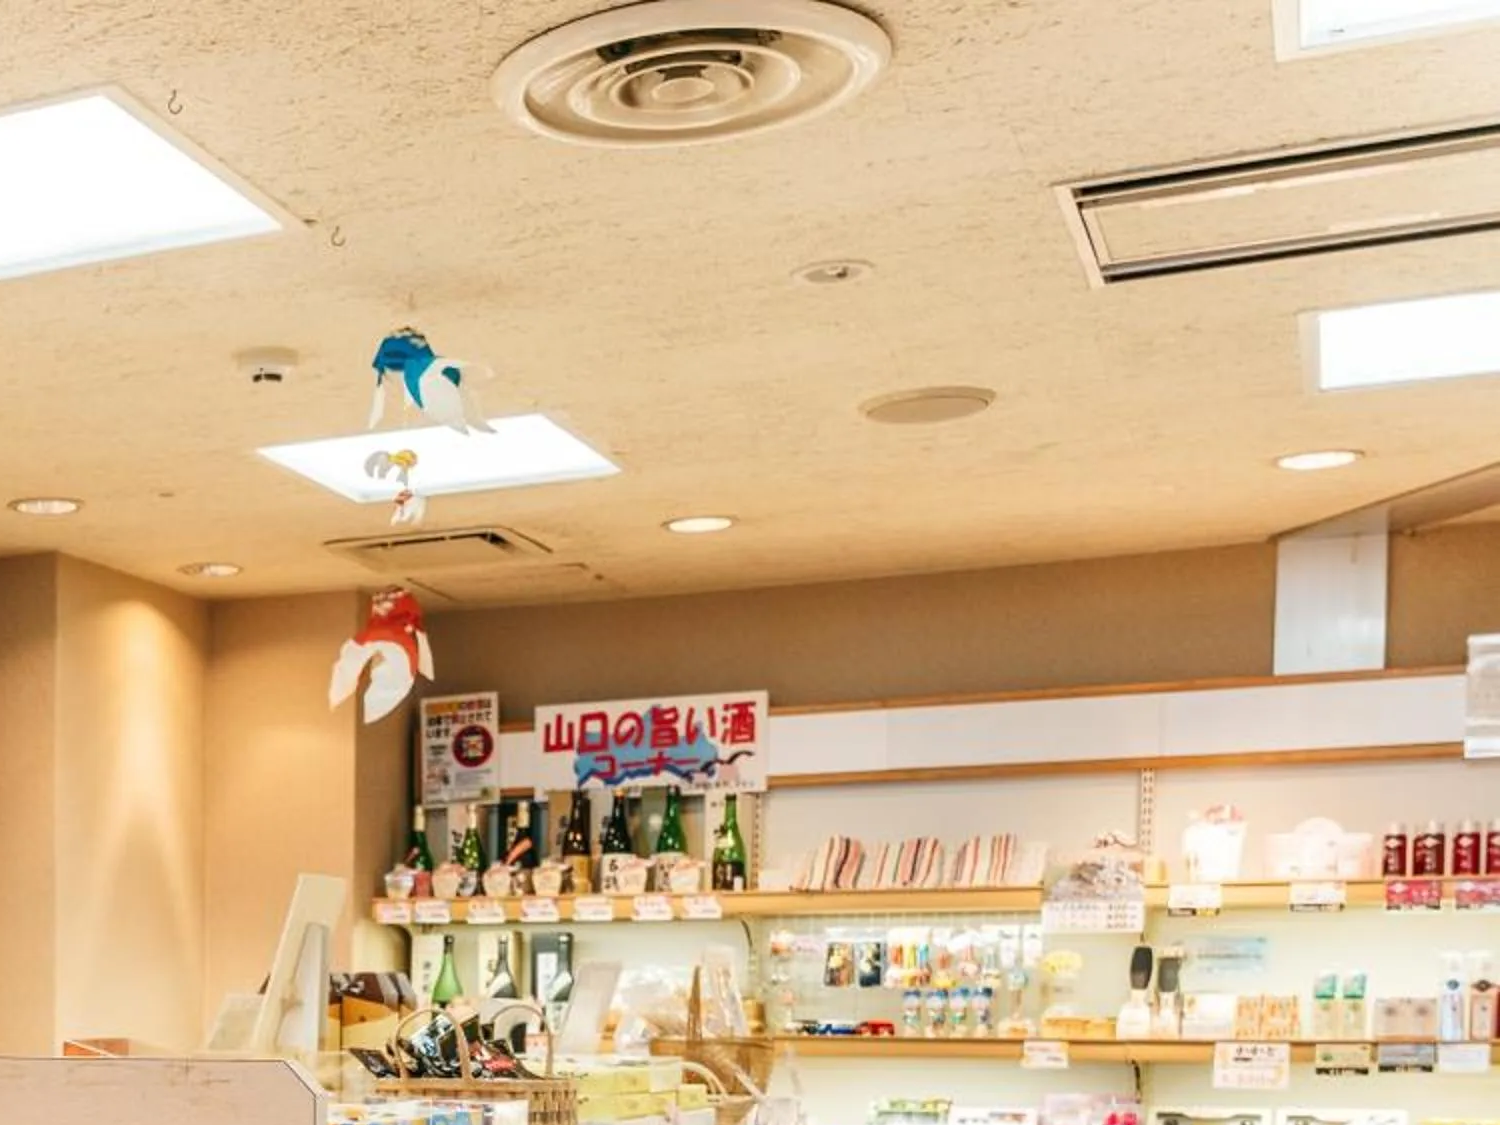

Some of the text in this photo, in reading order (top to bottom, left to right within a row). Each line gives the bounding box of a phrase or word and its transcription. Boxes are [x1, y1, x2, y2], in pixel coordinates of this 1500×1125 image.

[543, 701, 757, 755] 山口の旨い酒
[595, 751, 700, 778] コーナー
